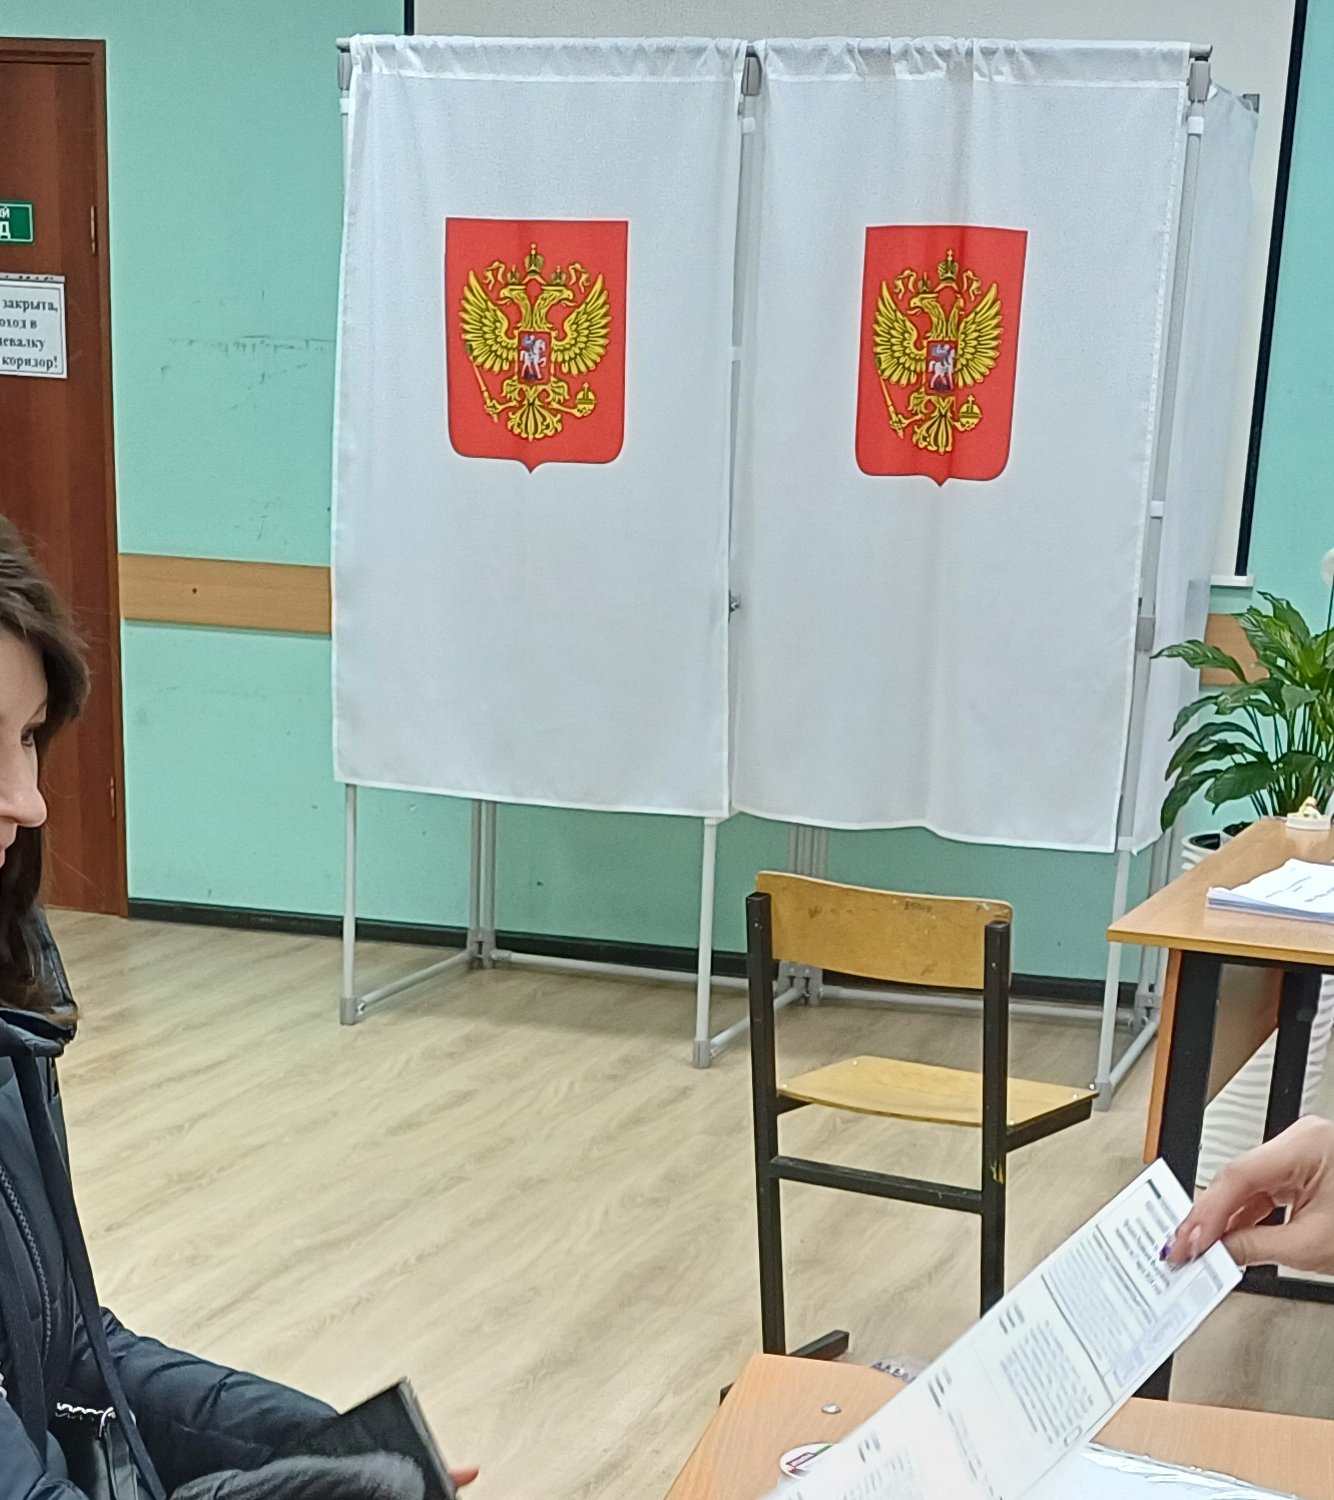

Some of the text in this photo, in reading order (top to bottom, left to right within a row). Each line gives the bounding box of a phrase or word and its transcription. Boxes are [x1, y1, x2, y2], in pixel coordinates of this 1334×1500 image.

[2, 299, 58, 313] закрыта,
[30, 320, 37, 329] в
[2, 356, 58, 372] коридор!
